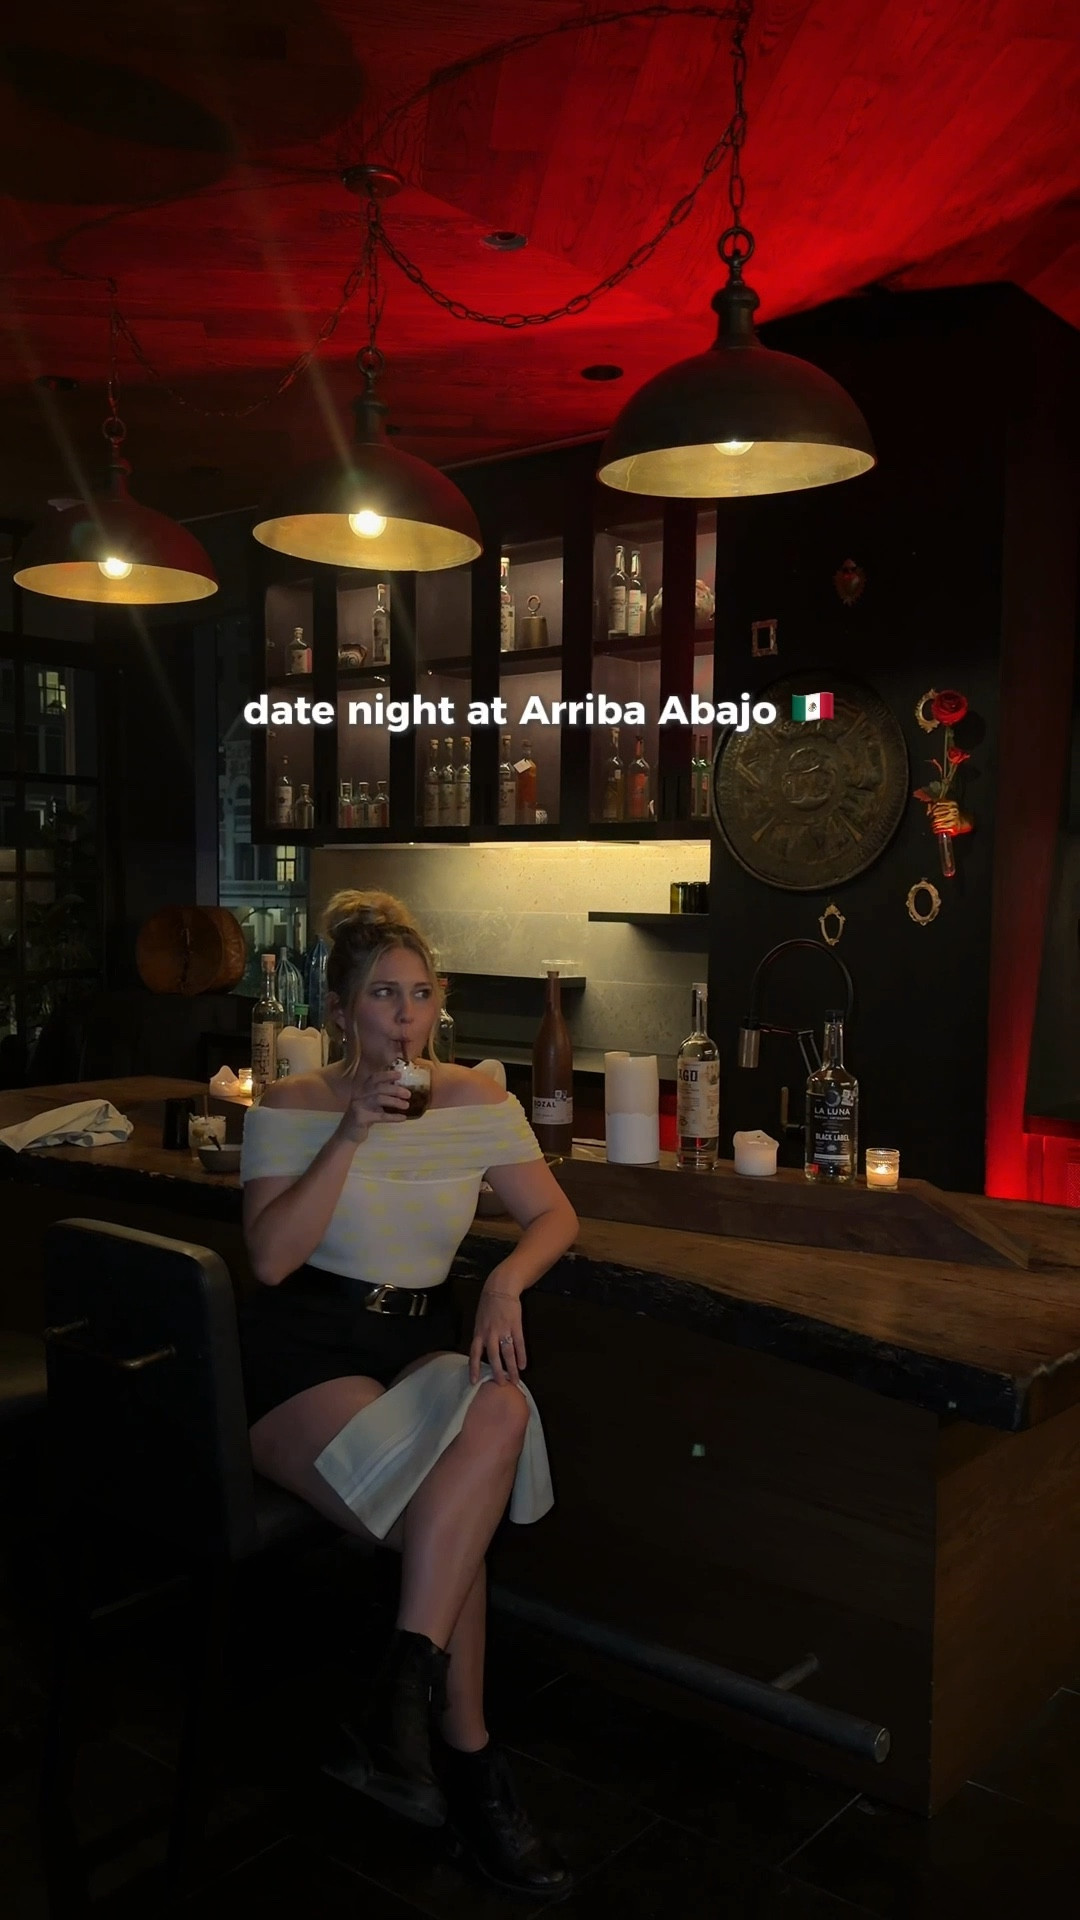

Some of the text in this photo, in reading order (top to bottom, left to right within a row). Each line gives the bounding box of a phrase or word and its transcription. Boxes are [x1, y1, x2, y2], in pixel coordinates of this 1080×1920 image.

[814, 1106, 851, 1116] LA LUNA
[815, 1132, 833, 1141] BLACK
[833, 1134, 850, 1142] LABEL
